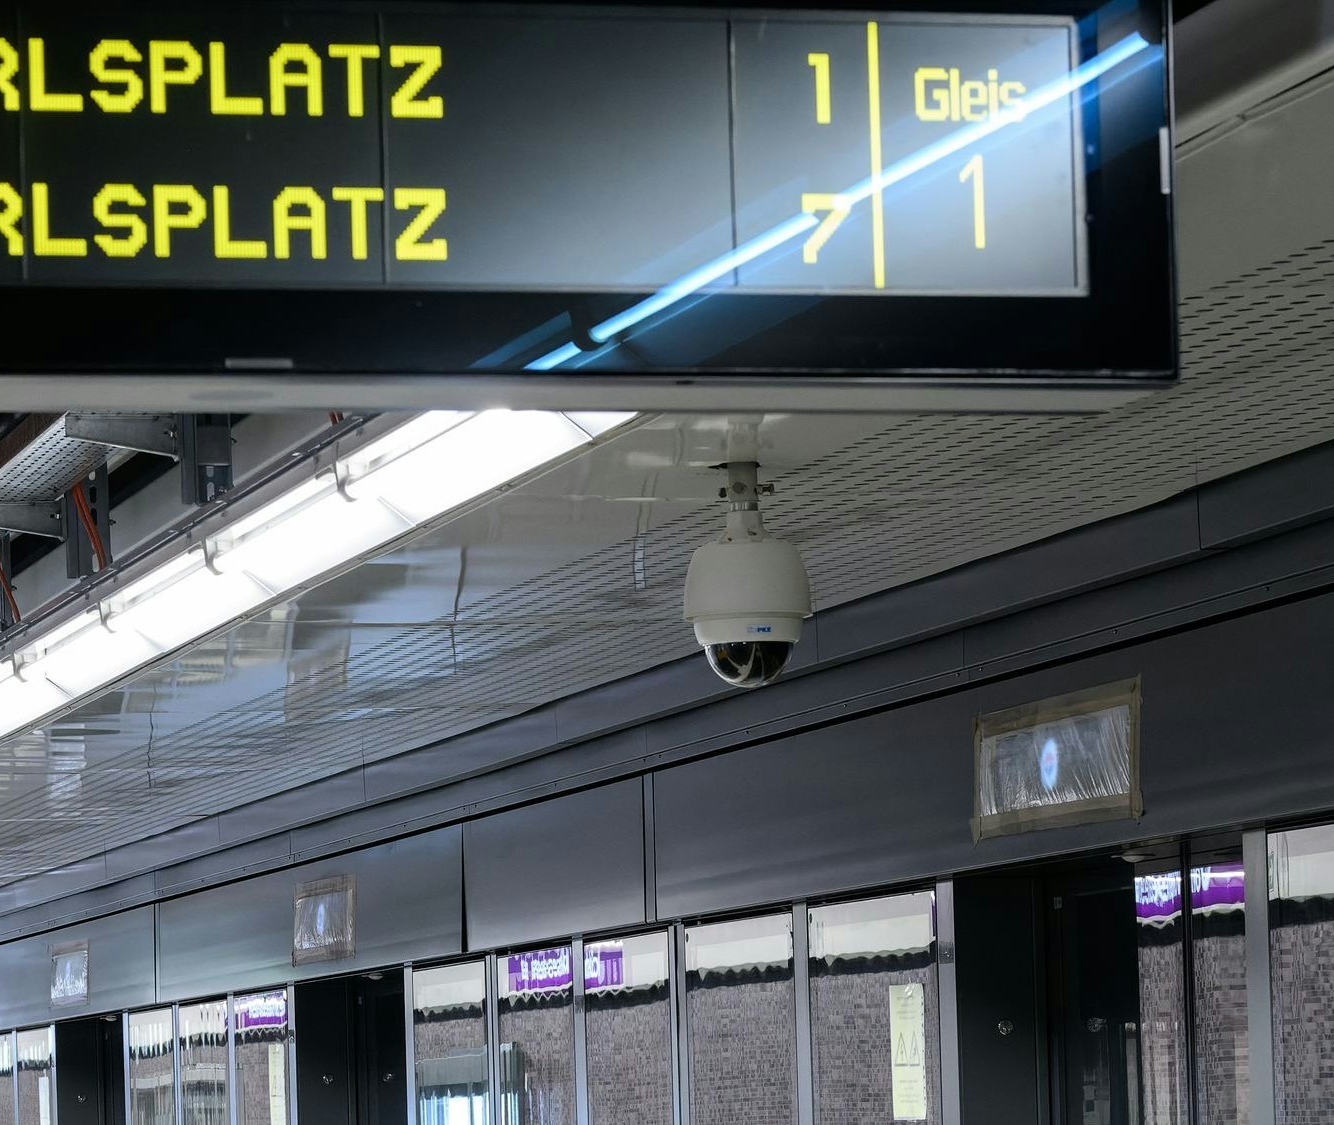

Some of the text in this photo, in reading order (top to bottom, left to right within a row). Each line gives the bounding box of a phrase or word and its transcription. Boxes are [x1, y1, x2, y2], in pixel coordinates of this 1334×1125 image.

[808, 53, 831, 124] 1
[914, 67, 1027, 122] Gleis
[801, 193, 851, 264] 7
[959, 155, 986, 249] 1
